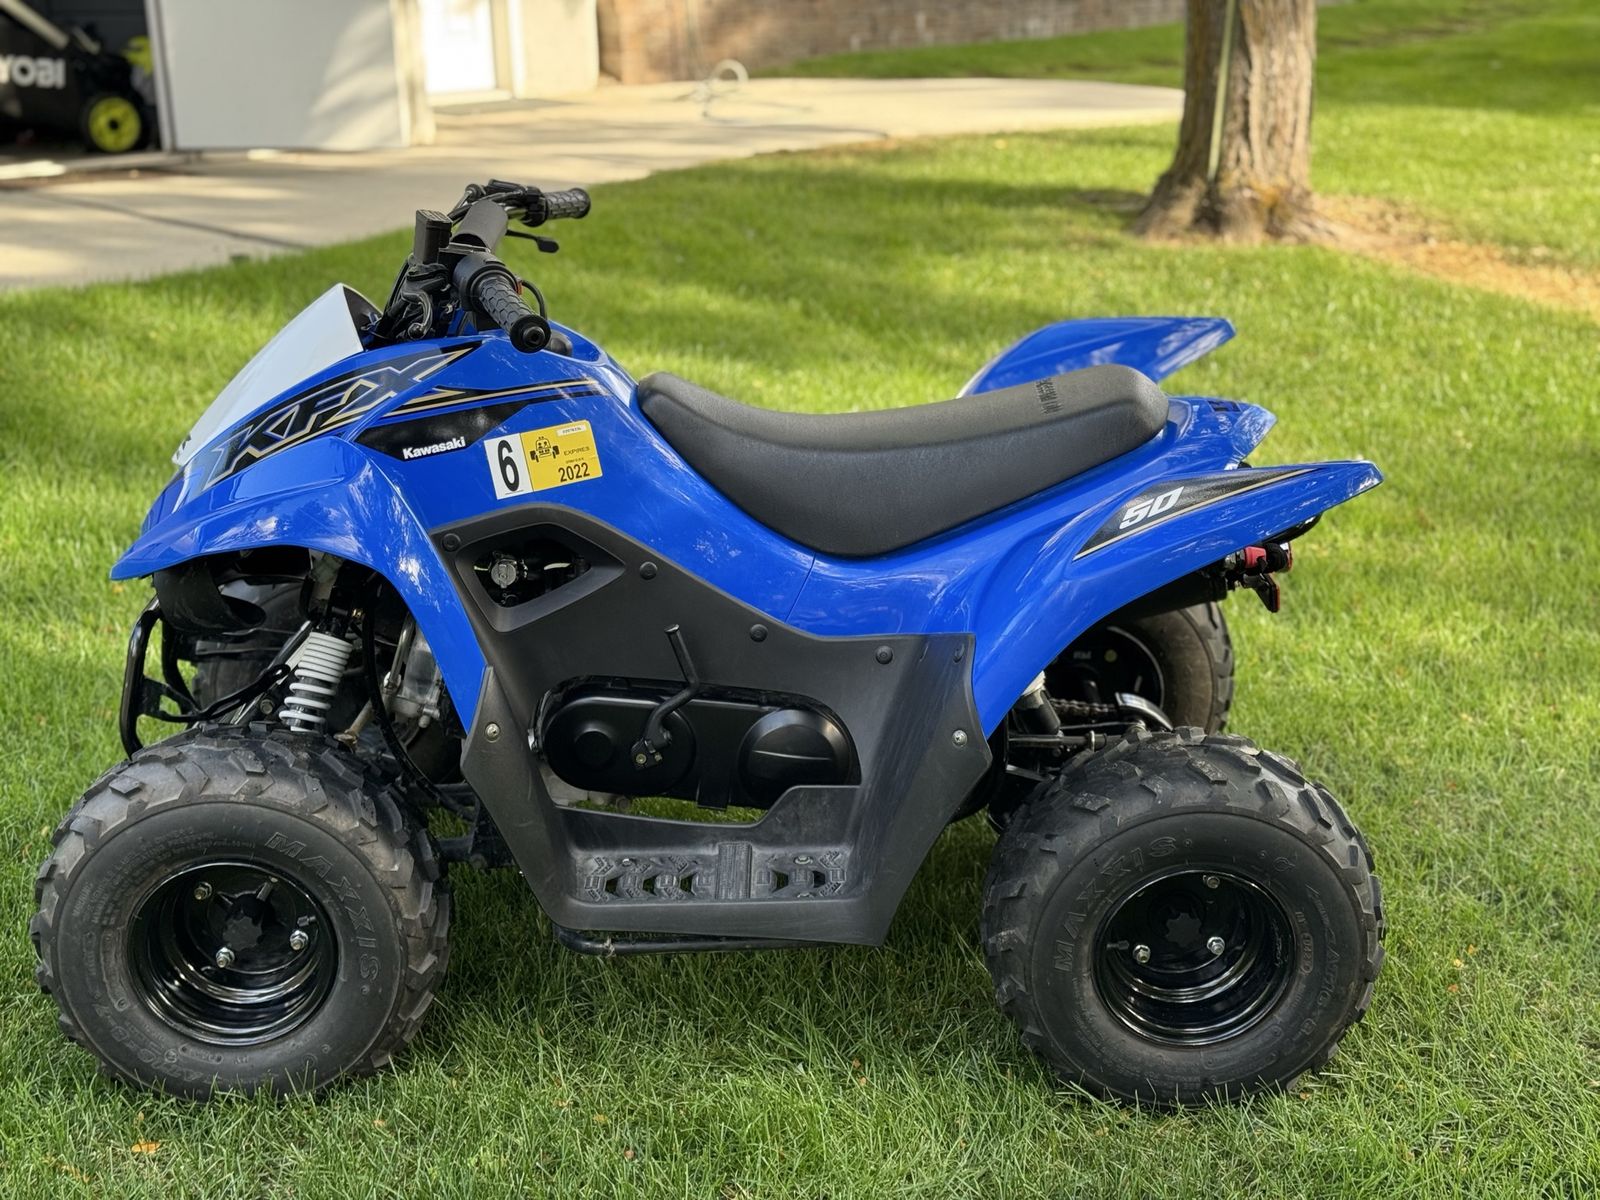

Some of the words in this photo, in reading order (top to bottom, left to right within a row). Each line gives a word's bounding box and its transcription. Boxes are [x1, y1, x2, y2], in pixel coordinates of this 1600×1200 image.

[203, 347, 473, 489] KFX
[402, 436, 466, 460] Kawasaki
[497, 440, 519, 491] 6
[558, 462, 590, 482] 2022
[1119, 486, 1185, 530] 50
[264, 831, 382, 982] MAXXIS
[1054, 836, 1178, 972] MAXXIS
